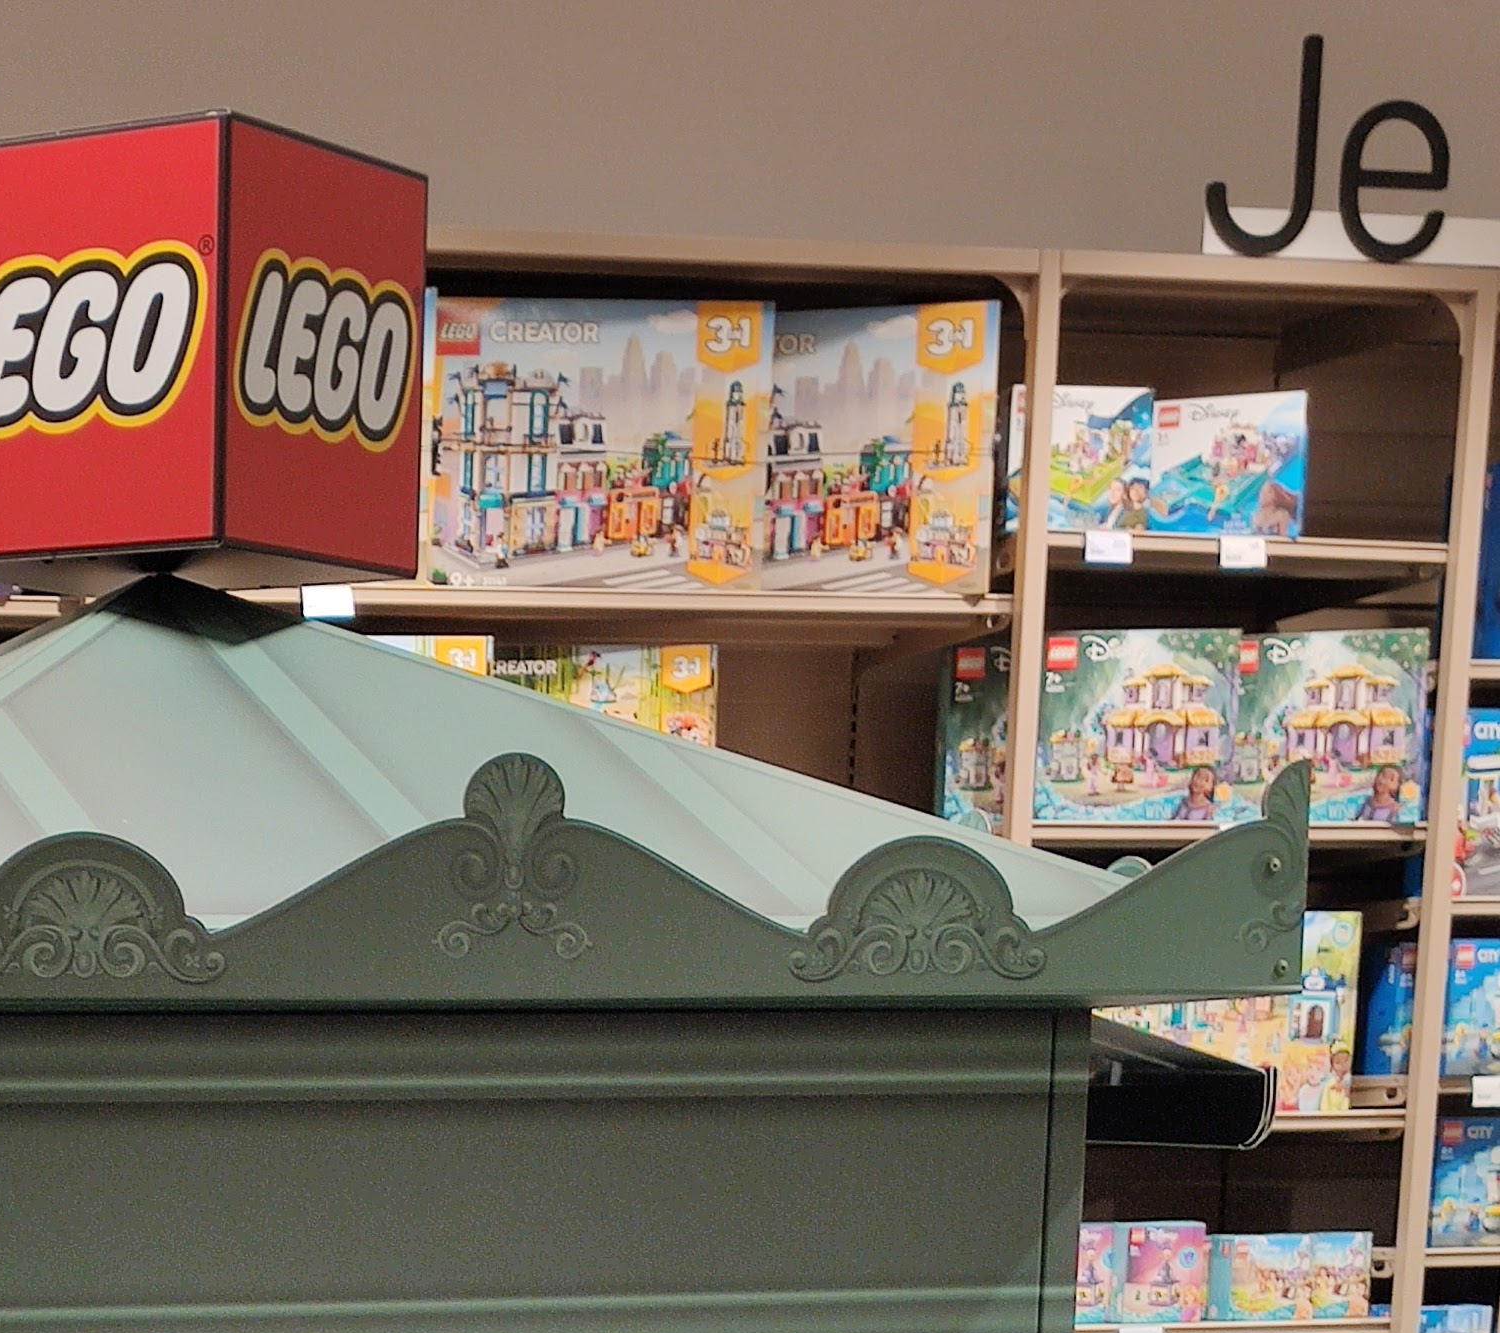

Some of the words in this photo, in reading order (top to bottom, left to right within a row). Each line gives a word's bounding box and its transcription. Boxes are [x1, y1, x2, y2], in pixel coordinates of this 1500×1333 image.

[1205, 34, 1449, 263] Je
[239, 257, 412, 443] LEGO
[440, 321, 478, 341] LEGO
[489, 321, 599, 344] CREATOR
[1467, 1125, 1493, 1140] CITY
